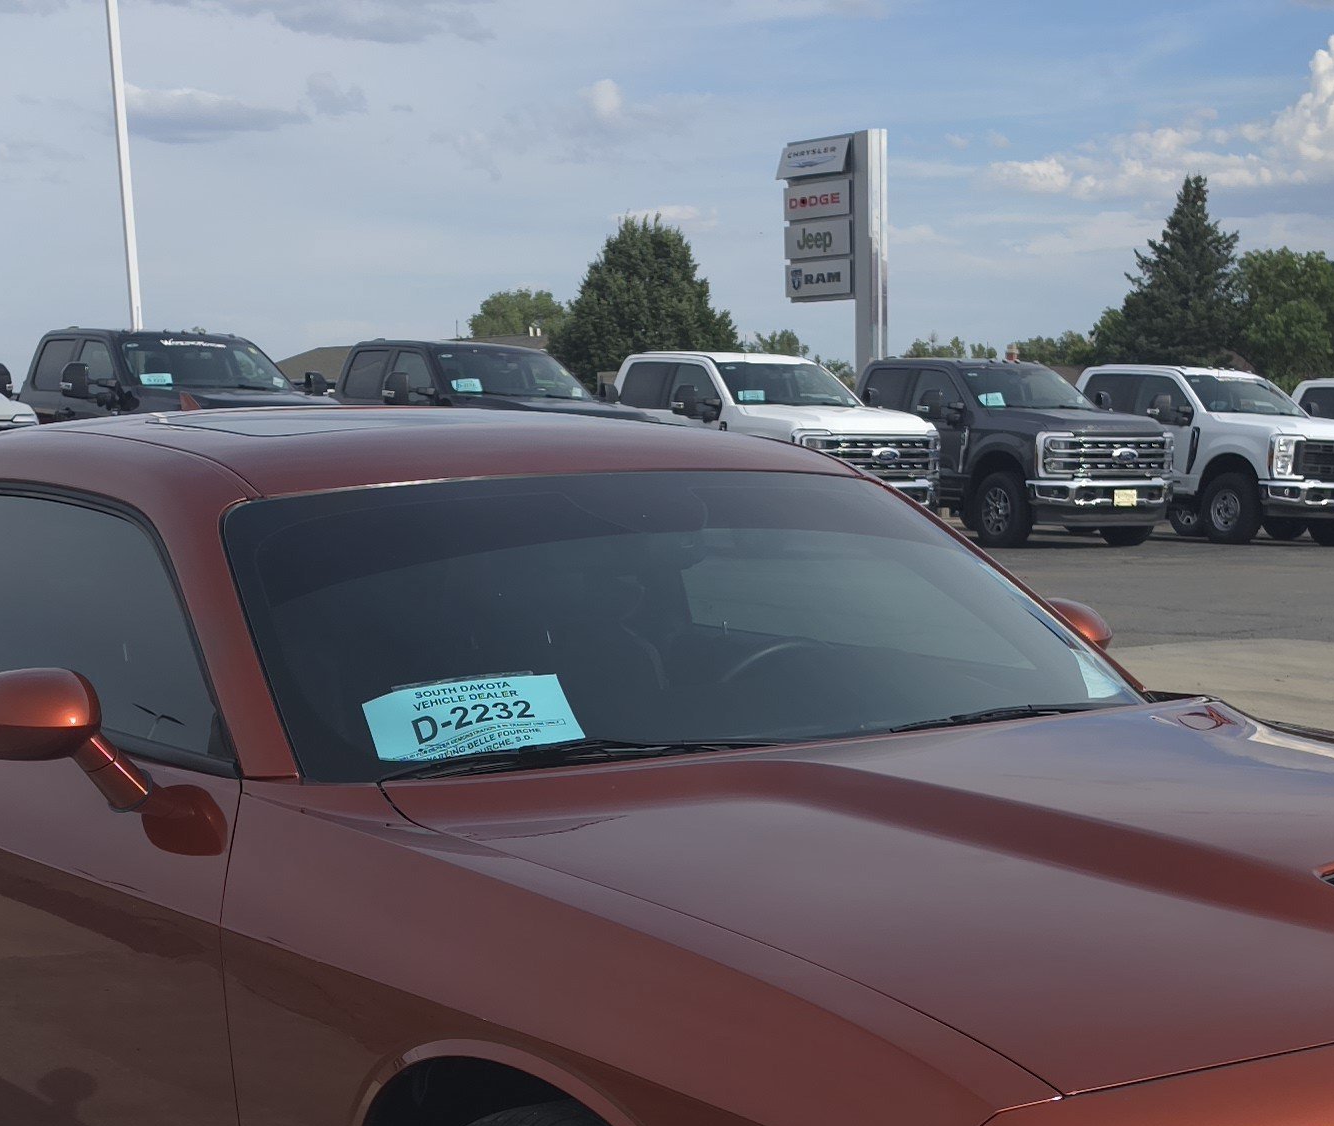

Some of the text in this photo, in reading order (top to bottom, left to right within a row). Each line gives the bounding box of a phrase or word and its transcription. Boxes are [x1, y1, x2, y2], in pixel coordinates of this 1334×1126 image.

[787, 145, 837, 159] CHRYSLER
[788, 192, 841, 210] DODGE
[797, 228, 833, 252] Jeep
[804, 270, 841, 285] RAM
[414, 681, 511, 700] SOUTH DAKOTA
[413, 689, 519, 712] VEHICLE DEALER
[410, 699, 536, 746] D-2232
[467, 733, 496, 750] BELLE
[475, 738, 515, 754] OURCHE,
